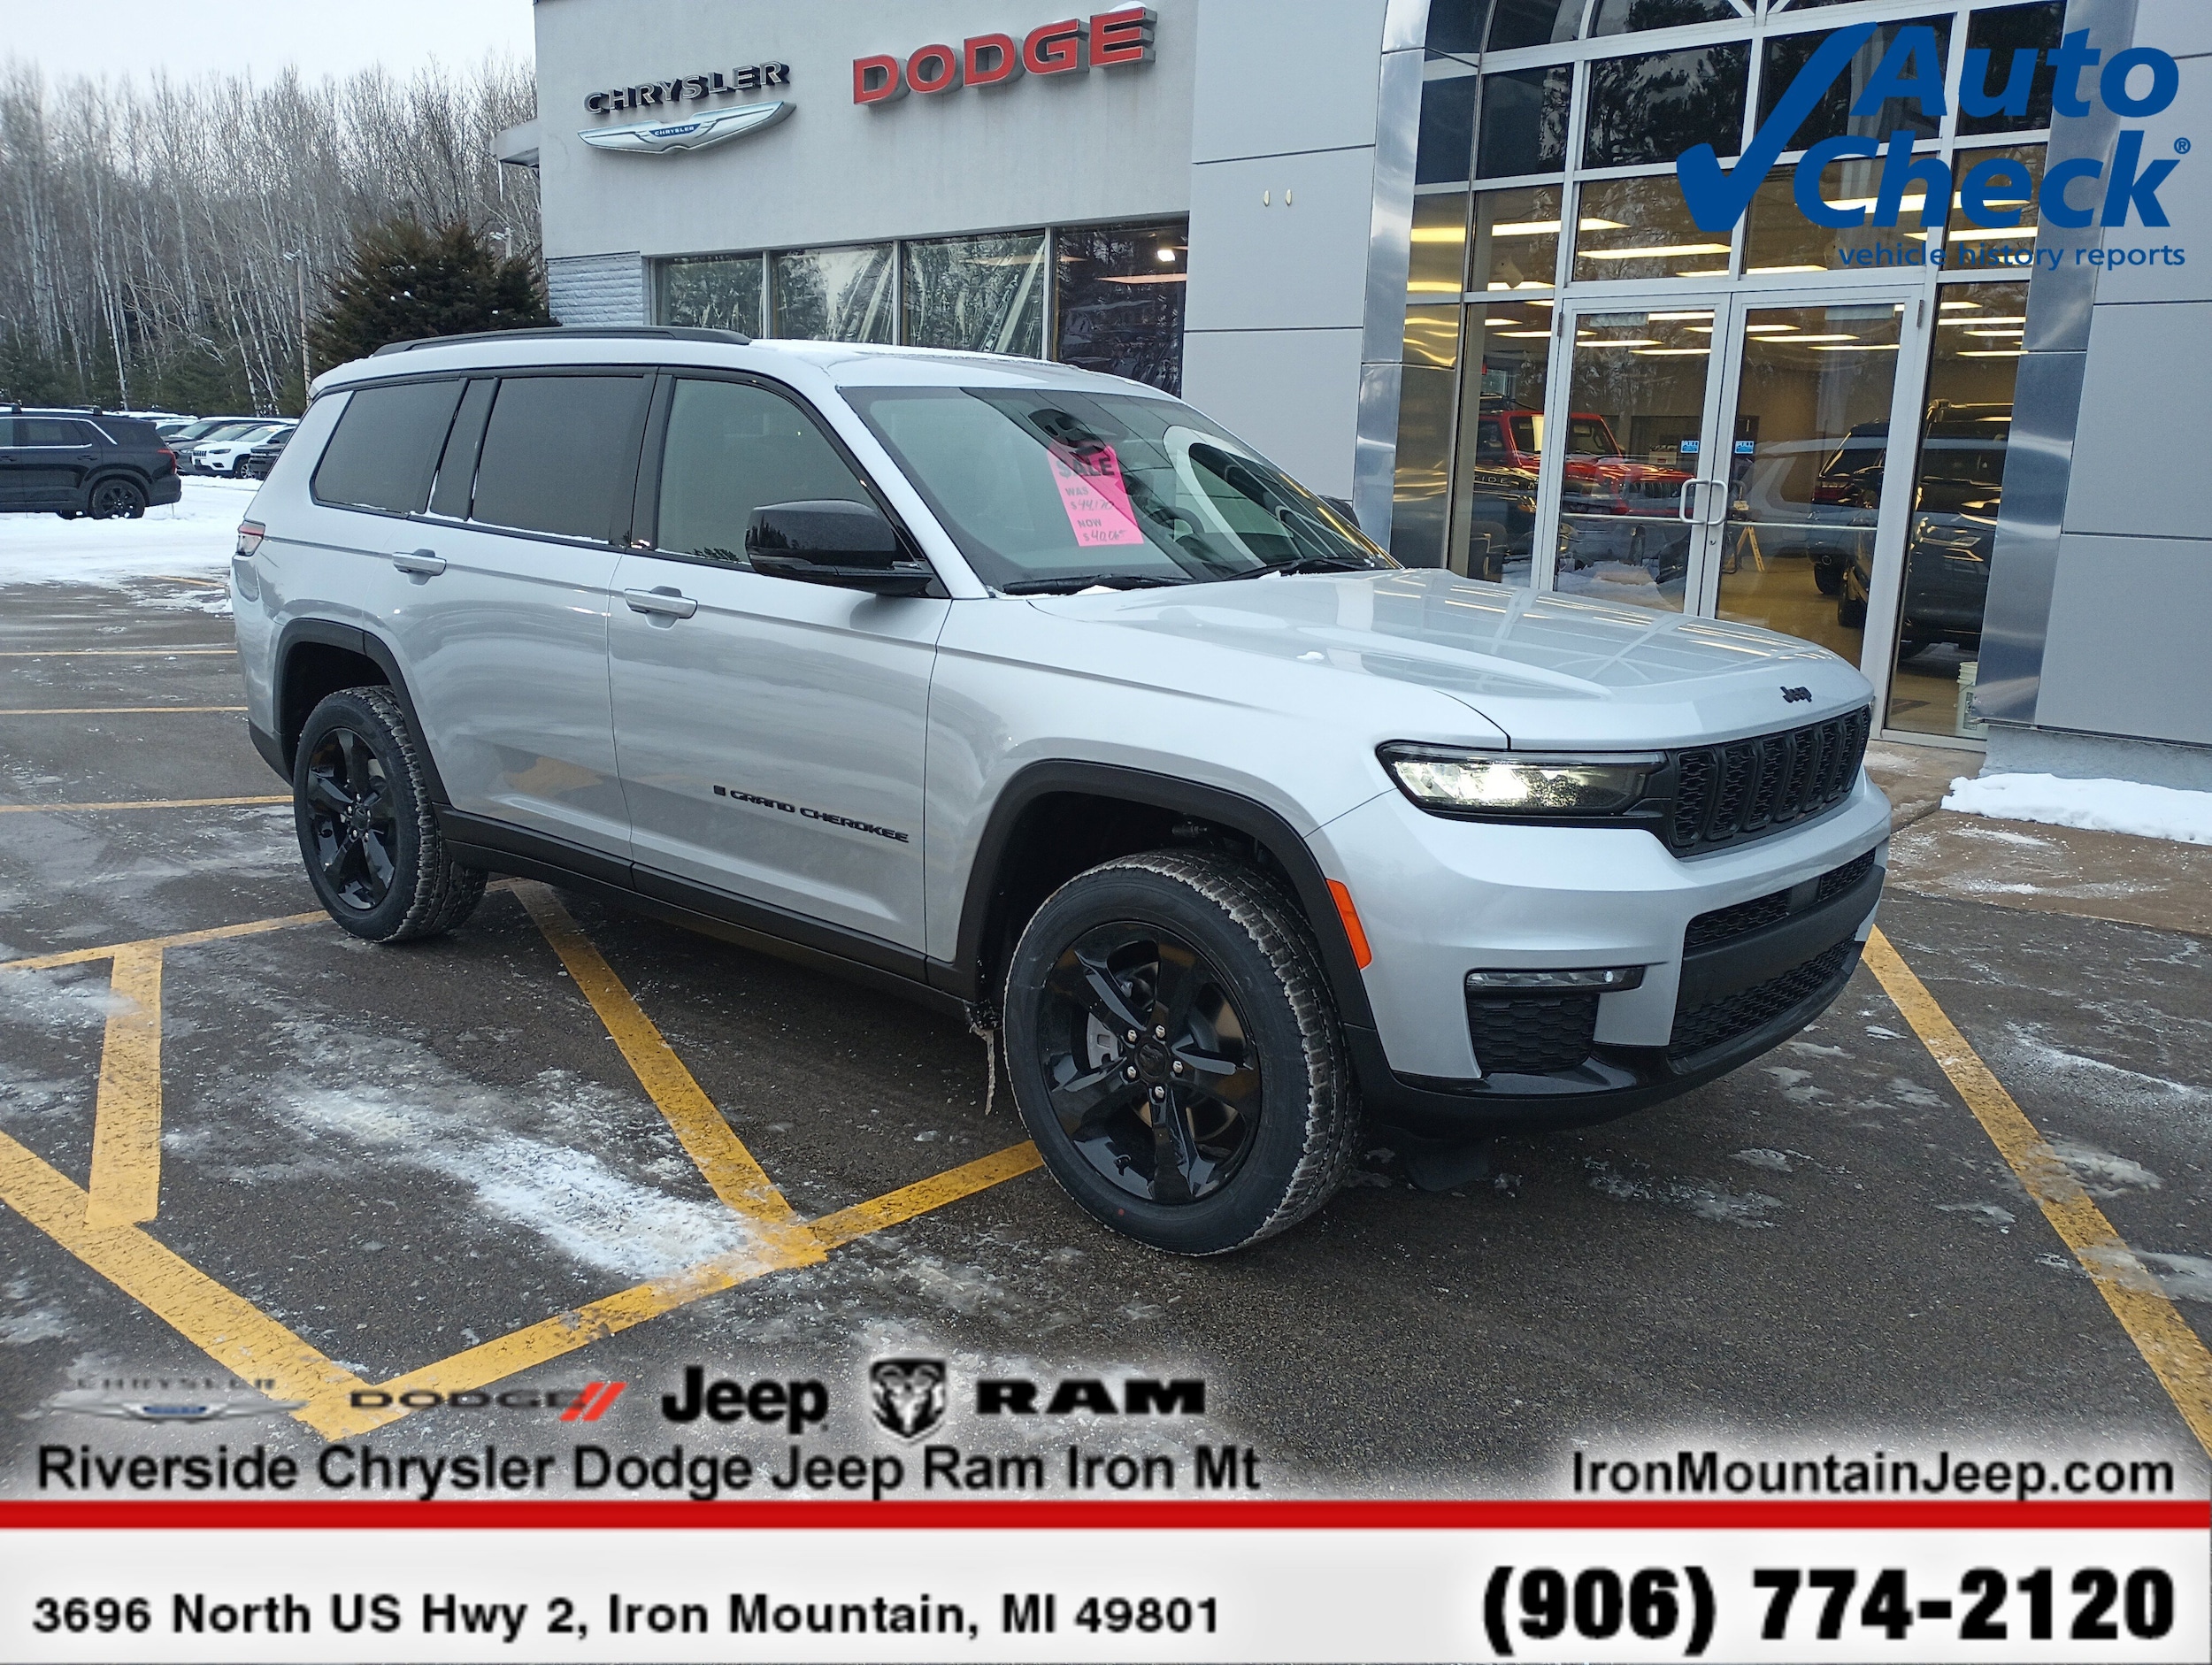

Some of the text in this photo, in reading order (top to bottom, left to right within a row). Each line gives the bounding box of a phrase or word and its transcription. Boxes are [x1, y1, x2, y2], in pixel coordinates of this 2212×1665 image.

[853, 7, 1155, 105] DODGE
[584, 61, 788, 115] CHRYSLER
[654, 126, 695, 136] CHRYSLER
[1065, 487, 1089, 496] WAS
[1078, 518, 1102, 528] NOW
[1779, 686, 1812, 703] Jeep
[730, 790, 910, 843] GRAND CHEROKEE
